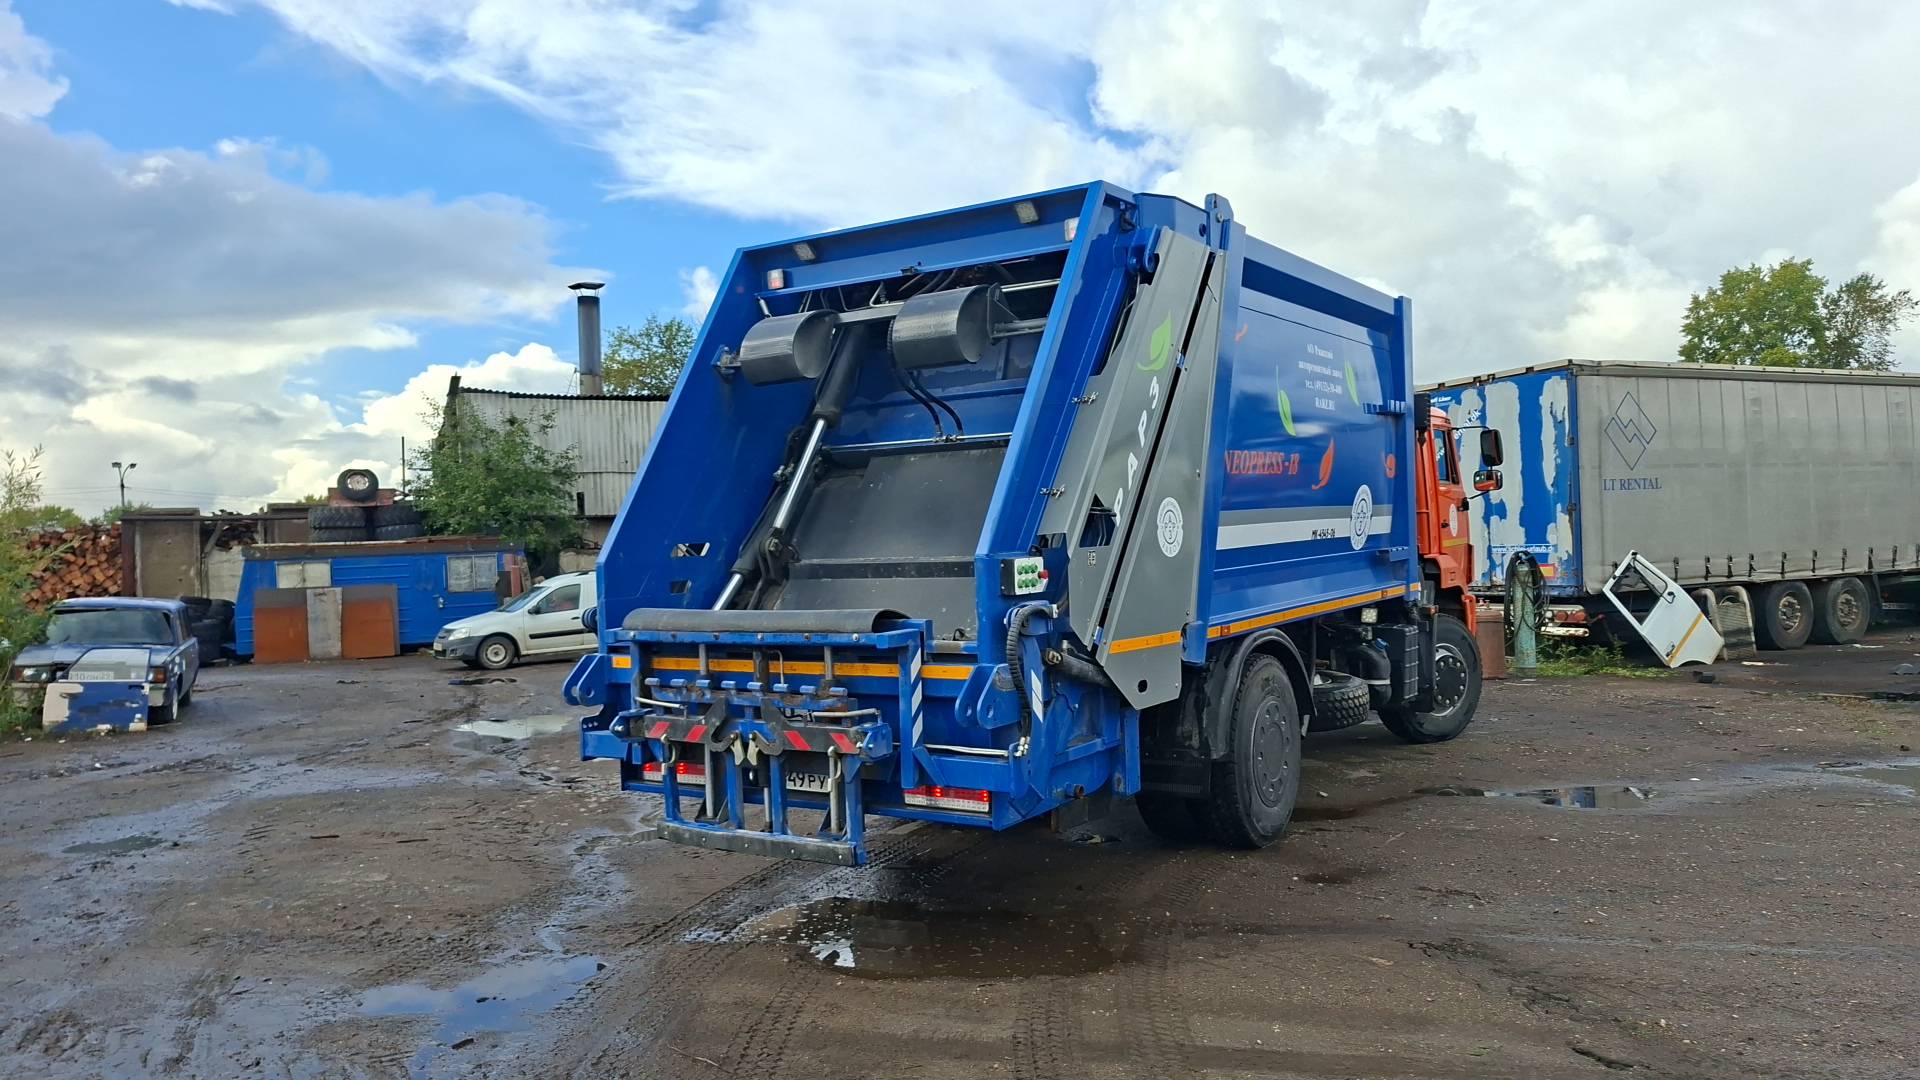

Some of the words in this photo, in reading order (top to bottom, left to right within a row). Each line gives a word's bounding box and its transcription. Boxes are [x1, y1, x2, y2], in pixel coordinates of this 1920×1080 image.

[1113, 375, 1159, 527] РАРЗ
[1603, 478, 1616, 491] LT
[1619, 477, 1662, 491] RENTAL
